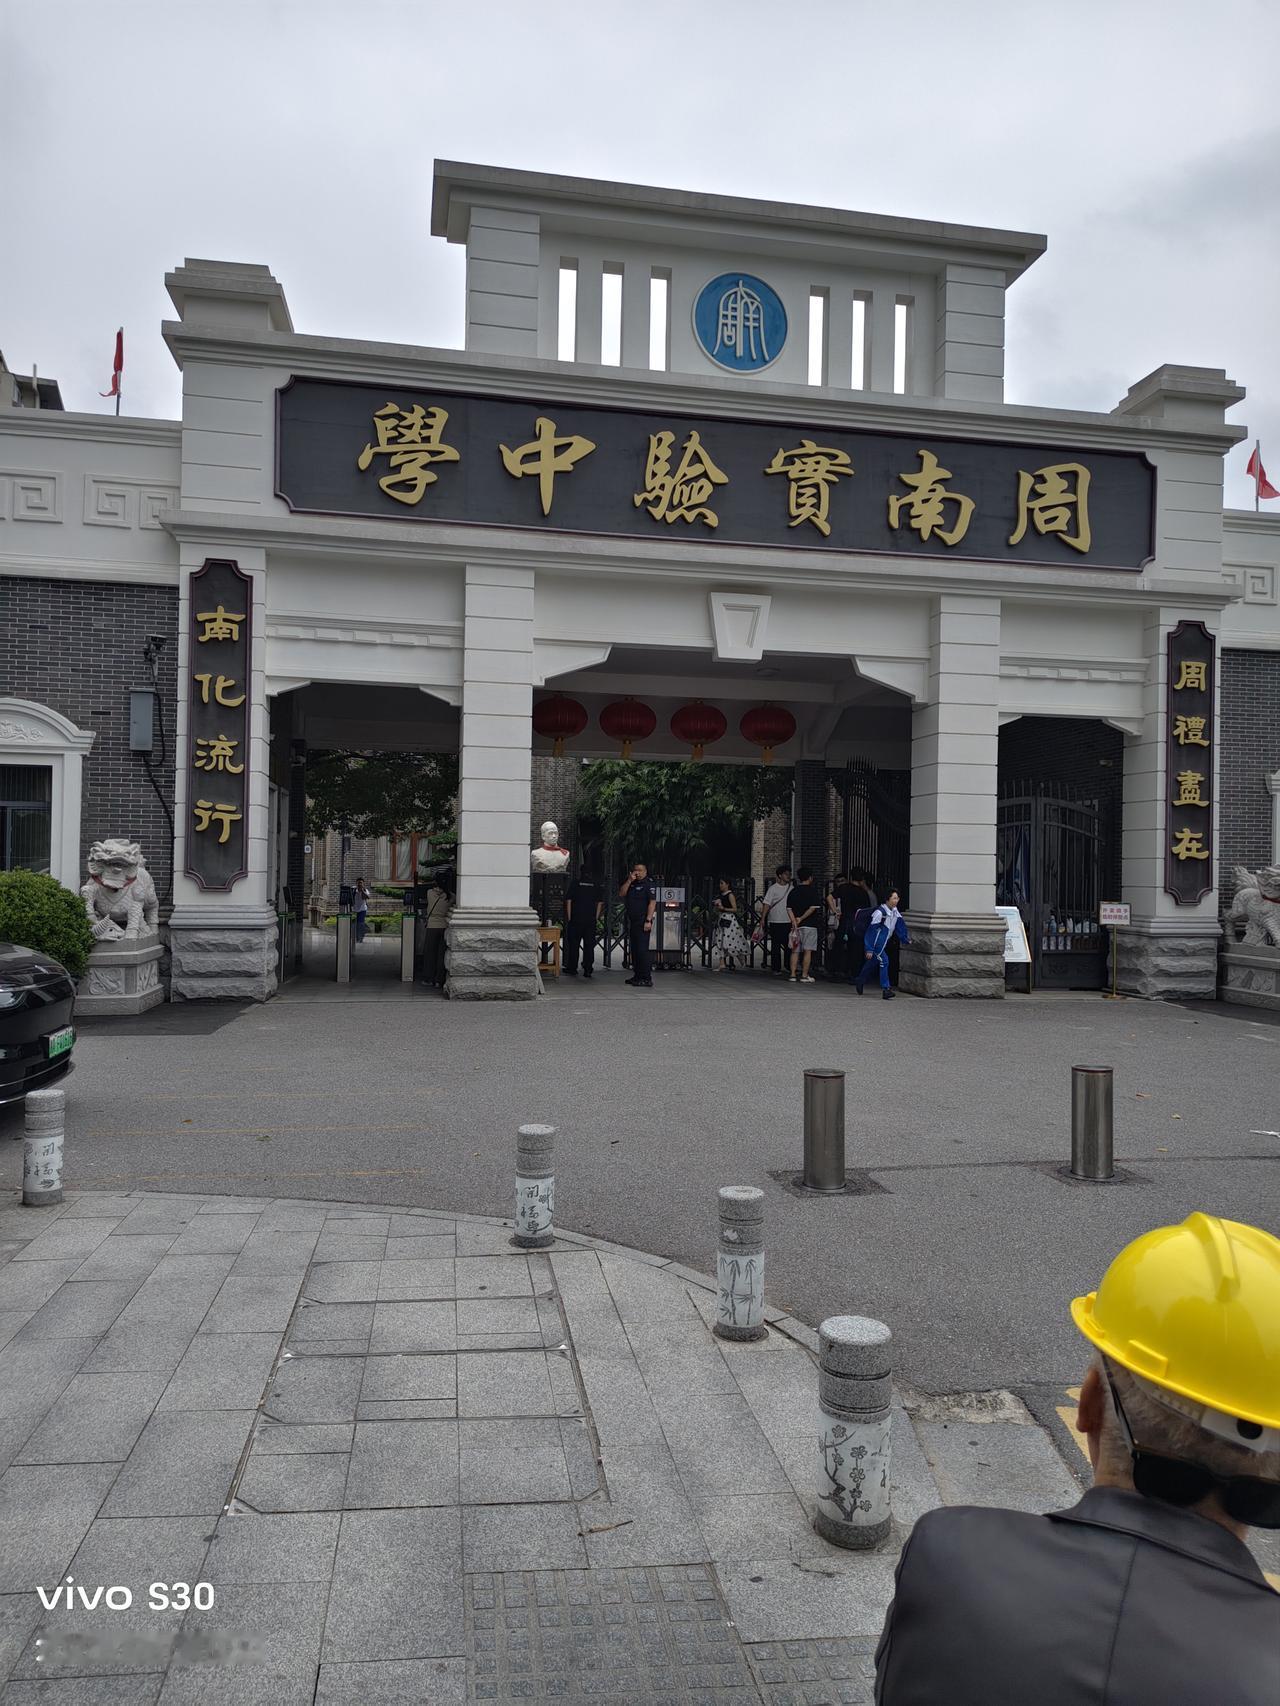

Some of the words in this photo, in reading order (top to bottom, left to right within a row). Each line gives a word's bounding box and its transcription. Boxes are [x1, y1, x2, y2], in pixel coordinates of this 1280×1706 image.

[357, 402, 1091, 553] 周南實驗中學
[194, 606, 246, 843] 南化流行
[1172, 661, 1210, 860] 周禮盡在
